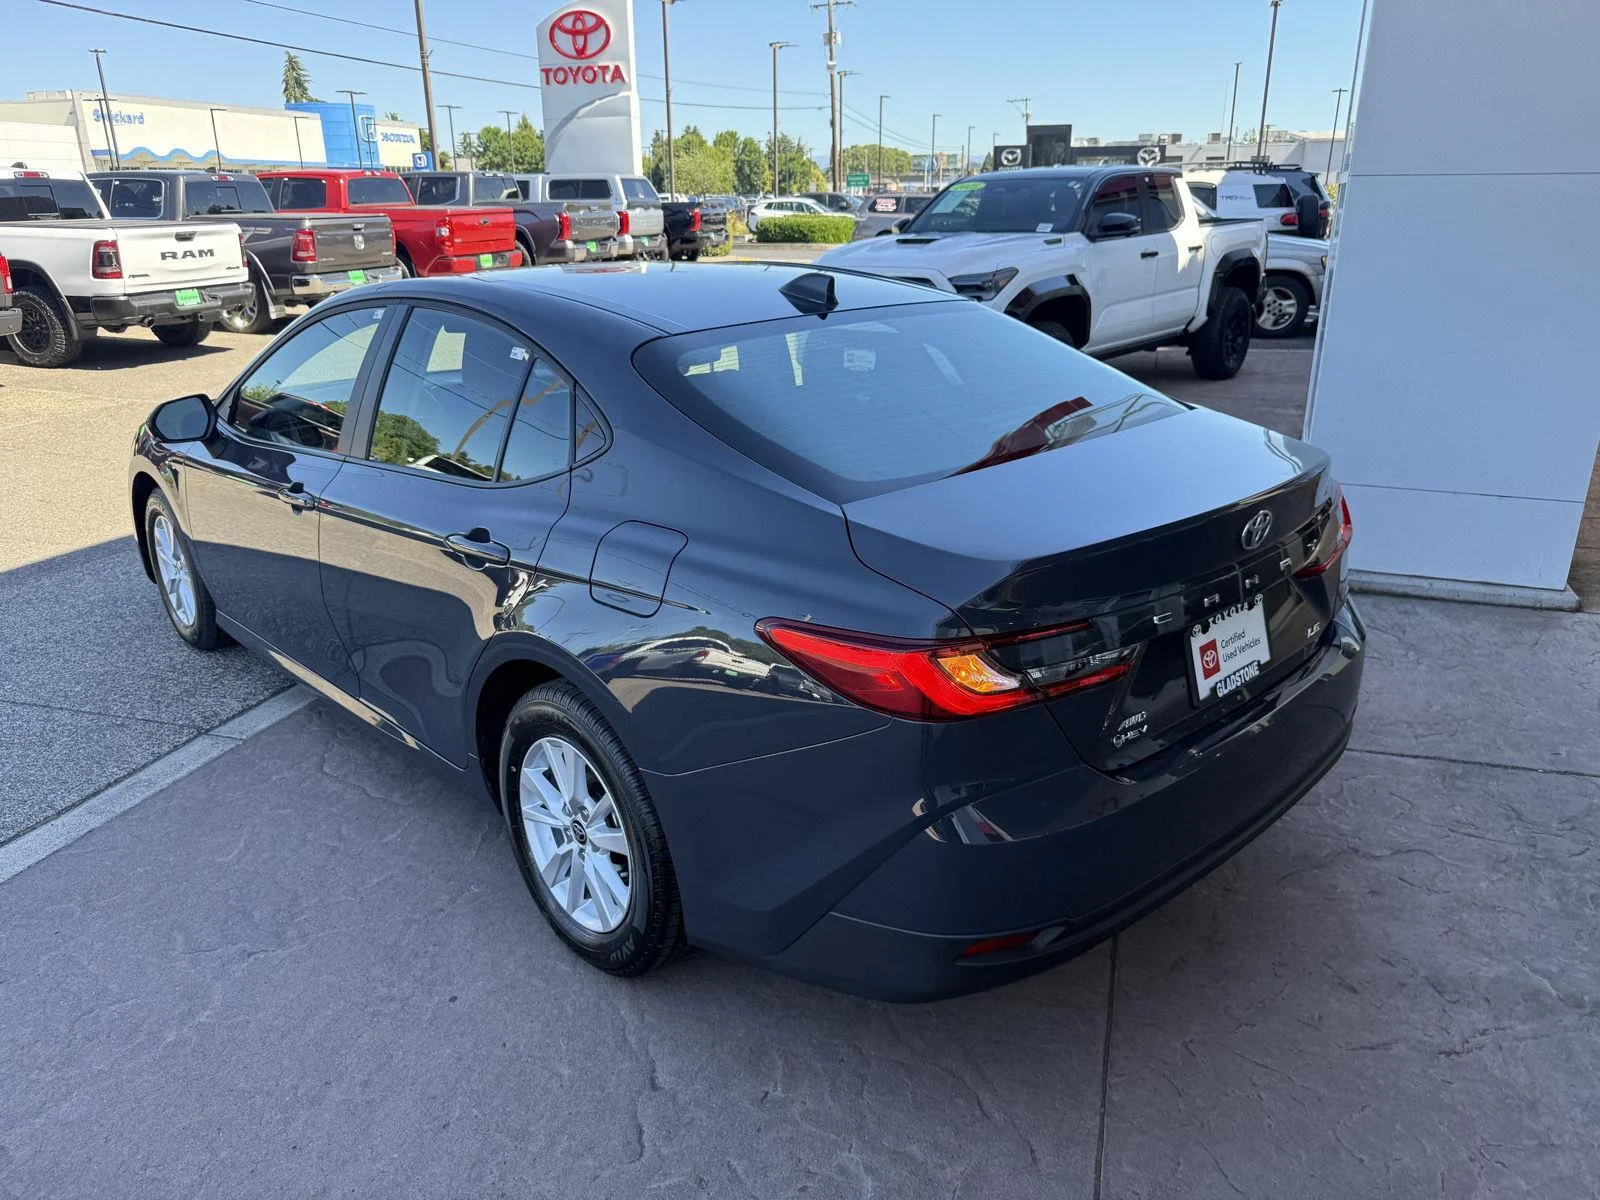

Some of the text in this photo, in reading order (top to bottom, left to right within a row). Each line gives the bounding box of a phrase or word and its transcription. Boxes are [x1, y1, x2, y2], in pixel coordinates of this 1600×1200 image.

[541, 65, 626, 86] TOYOTA
[380, 132, 416, 143] HONDA
[160, 248, 215, 261] RAM
[1207, 602, 1250, 627] TOYOTA
[1220, 628, 1246, 649] Certified
[1307, 622, 1321, 639] LE
[1222, 637, 1262, 663] Used Vehicles
[1216, 660, 1260, 698] GLADSTONE
[1117, 710, 1148, 732] AWD
